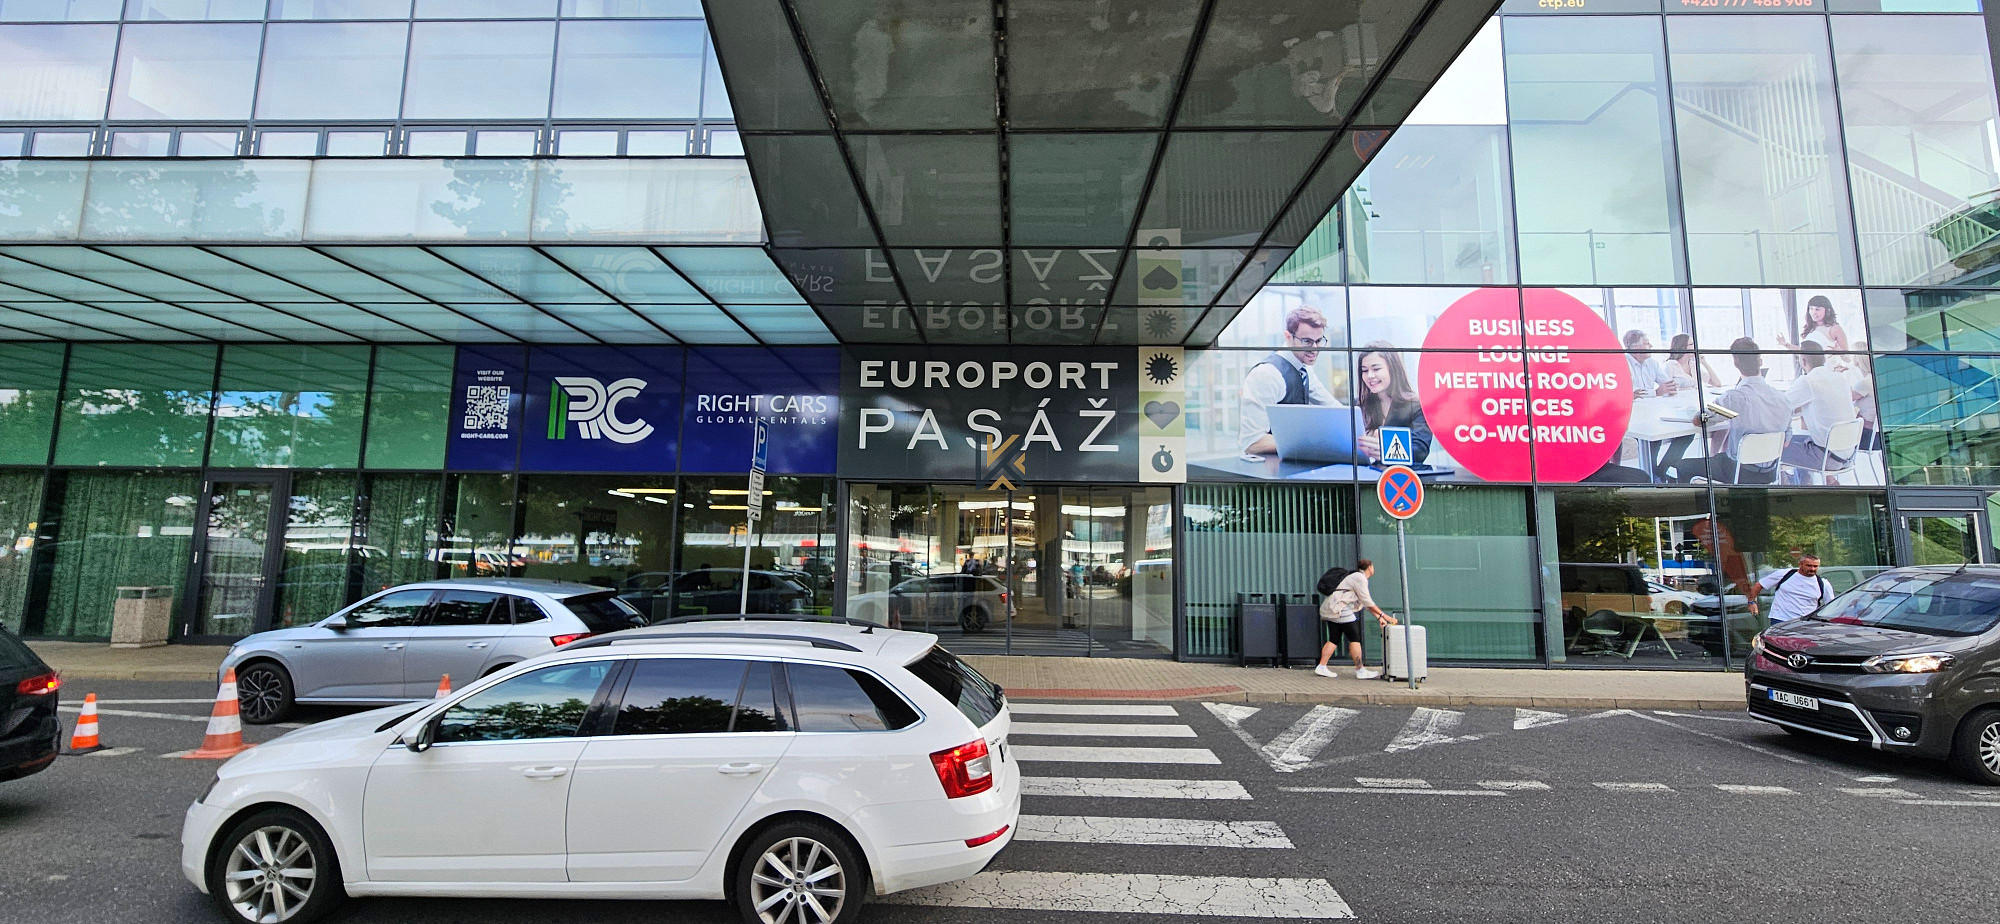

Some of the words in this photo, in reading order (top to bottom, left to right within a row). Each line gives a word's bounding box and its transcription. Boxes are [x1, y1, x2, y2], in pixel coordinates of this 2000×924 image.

[1538, 0, 1585, 10] ctp.eu
[1469, 319, 1575, 336] BUSINESS
[1477, 345, 1570, 363] LOUNGE
[859, 360, 1119, 390] EUROPORT
[1434, 372, 1533, 389] MEETING
[1537, 373, 1618, 390] ROOMS
[697, 394, 764, 412] RIGHT
[769, 395, 827, 414] CARS
[1481, 398, 1574, 417] OFFICES
[696, 415, 754, 424] GLOBAL
[858, 397, 1119, 452] PASÁŽ
[757, 425, 766, 454] P
[1454, 425, 1606, 444] CO-WORKING
[1775, 692, 1788, 702] 1AC
[1794, 695, 1814, 707] U661
